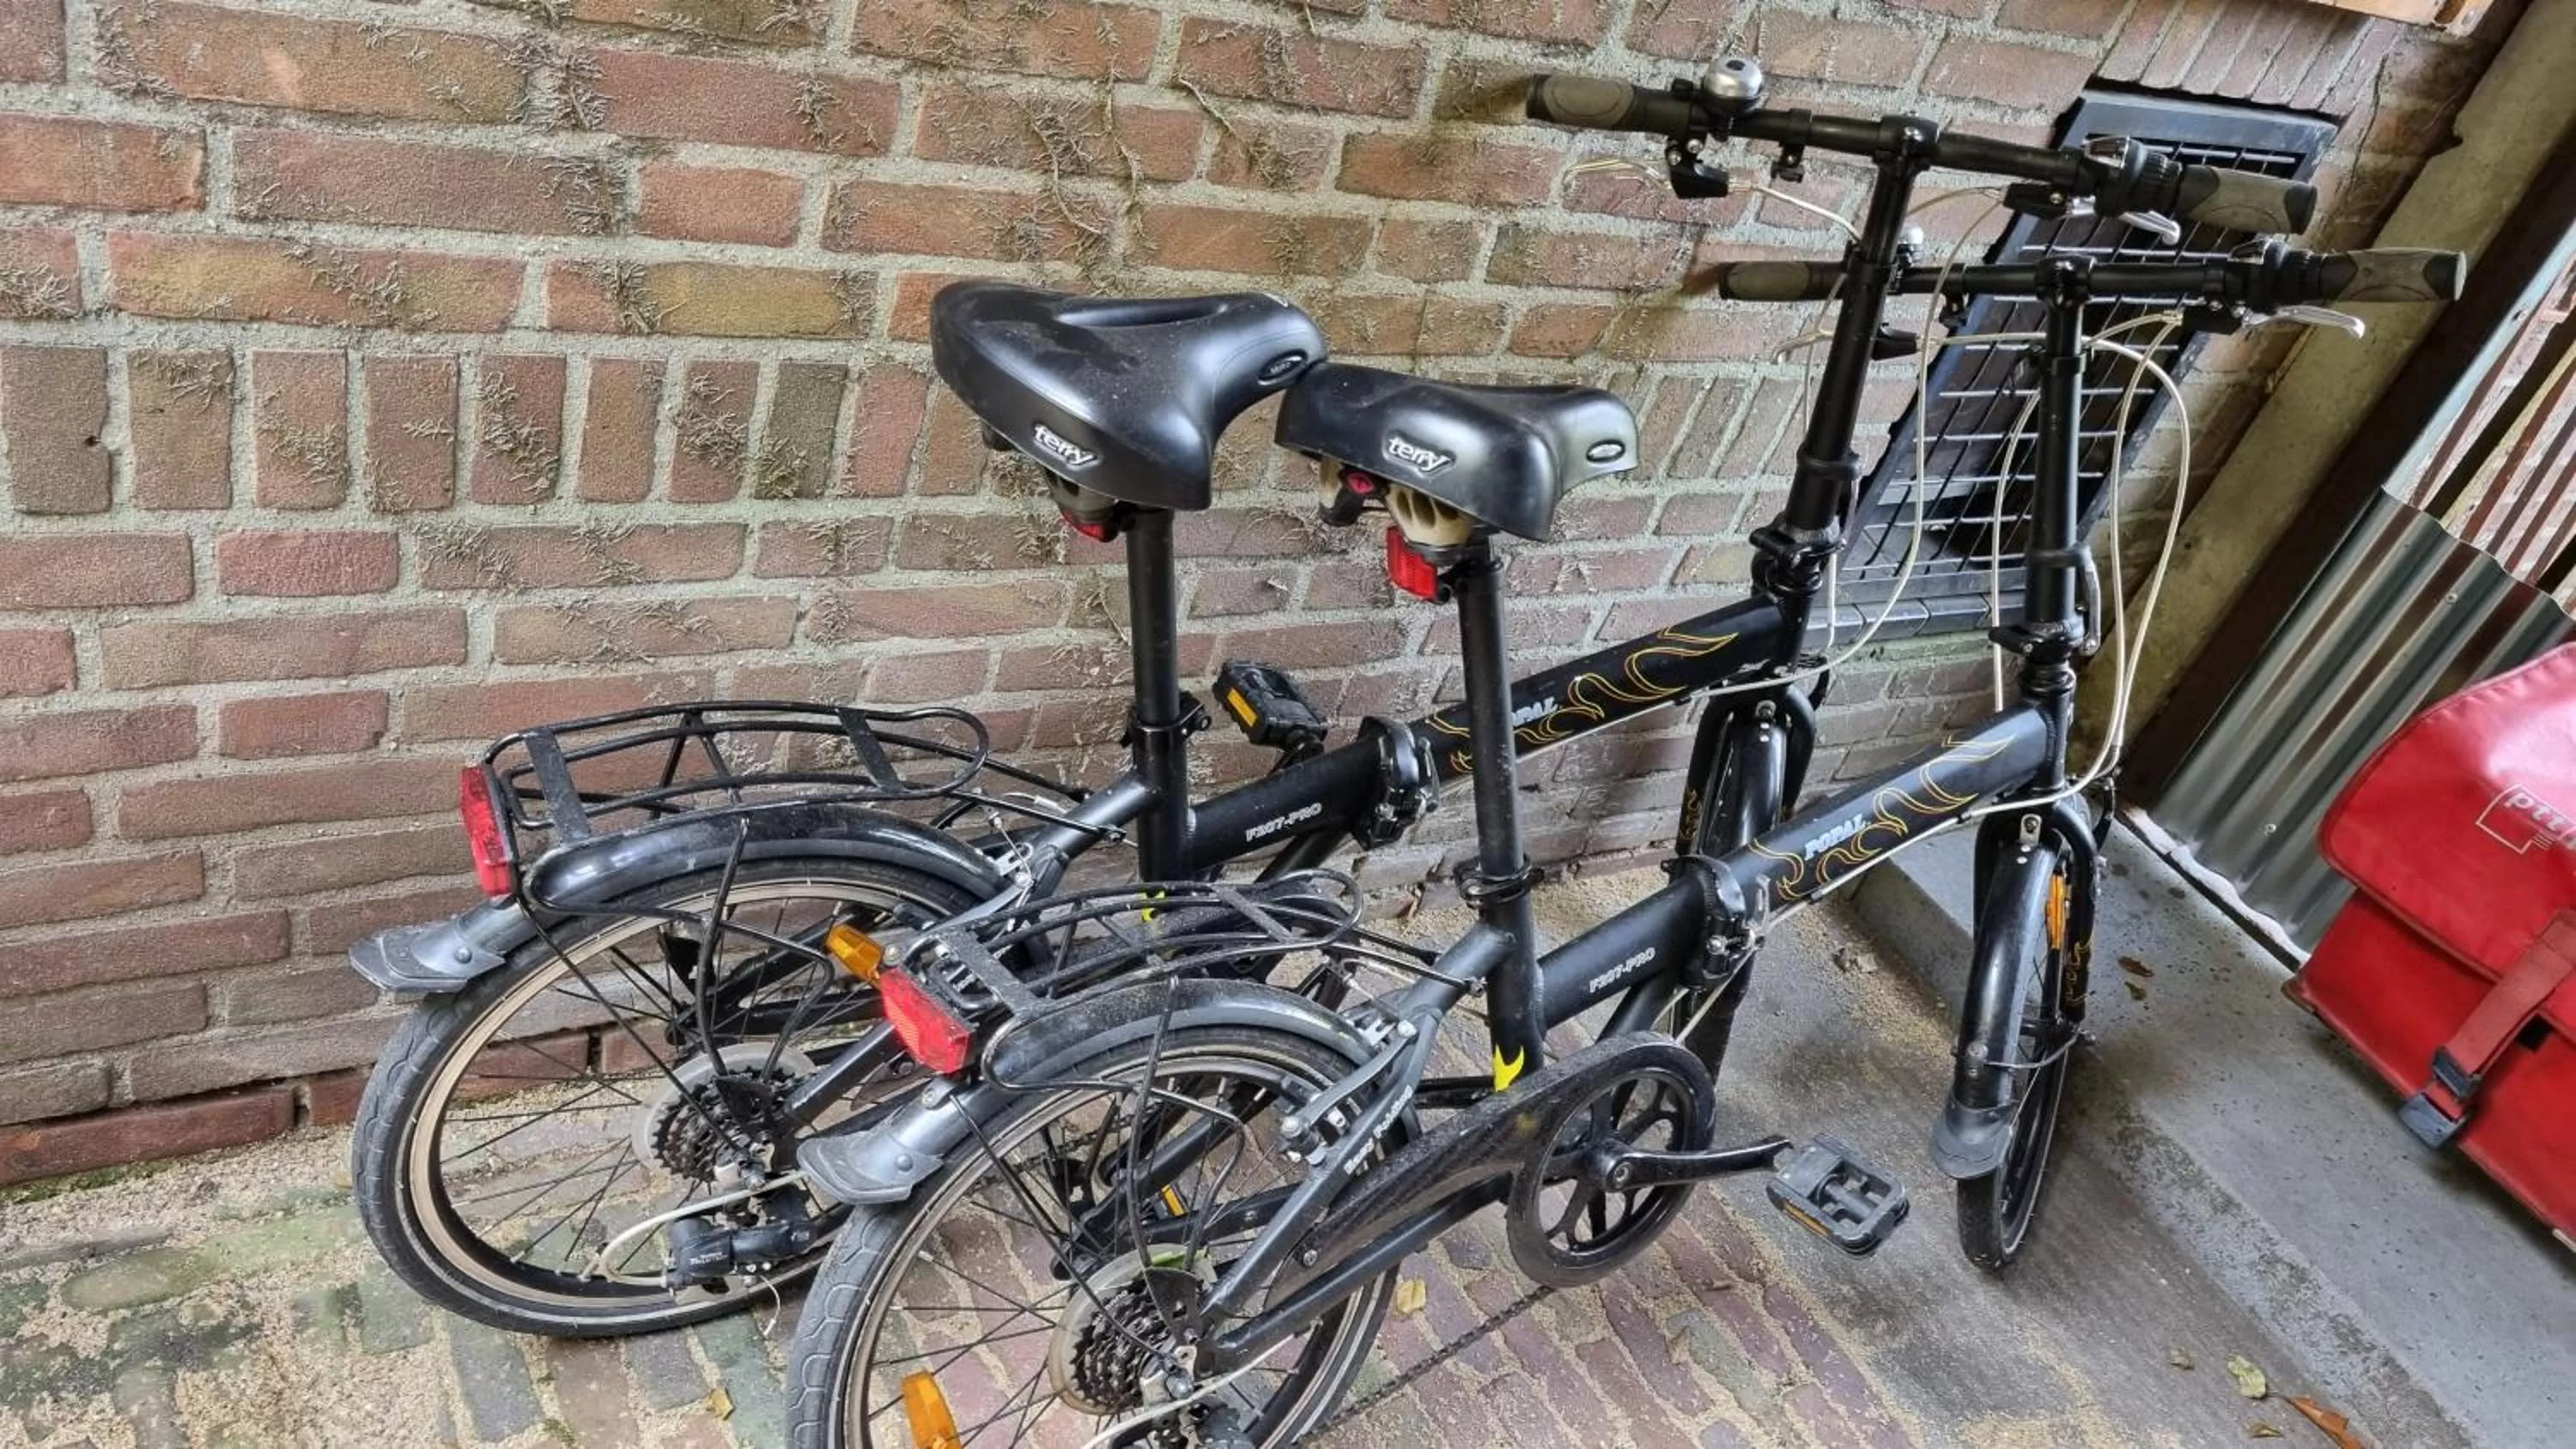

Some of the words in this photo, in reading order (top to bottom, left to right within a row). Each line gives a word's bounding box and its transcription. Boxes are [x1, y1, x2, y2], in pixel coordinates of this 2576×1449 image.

[1034, 425, 1095, 465] terry
[1388, 437, 1451, 471] terry
[2504, 792, 2565, 832] ptt
[1805, 814, 1866, 861] POPAL
